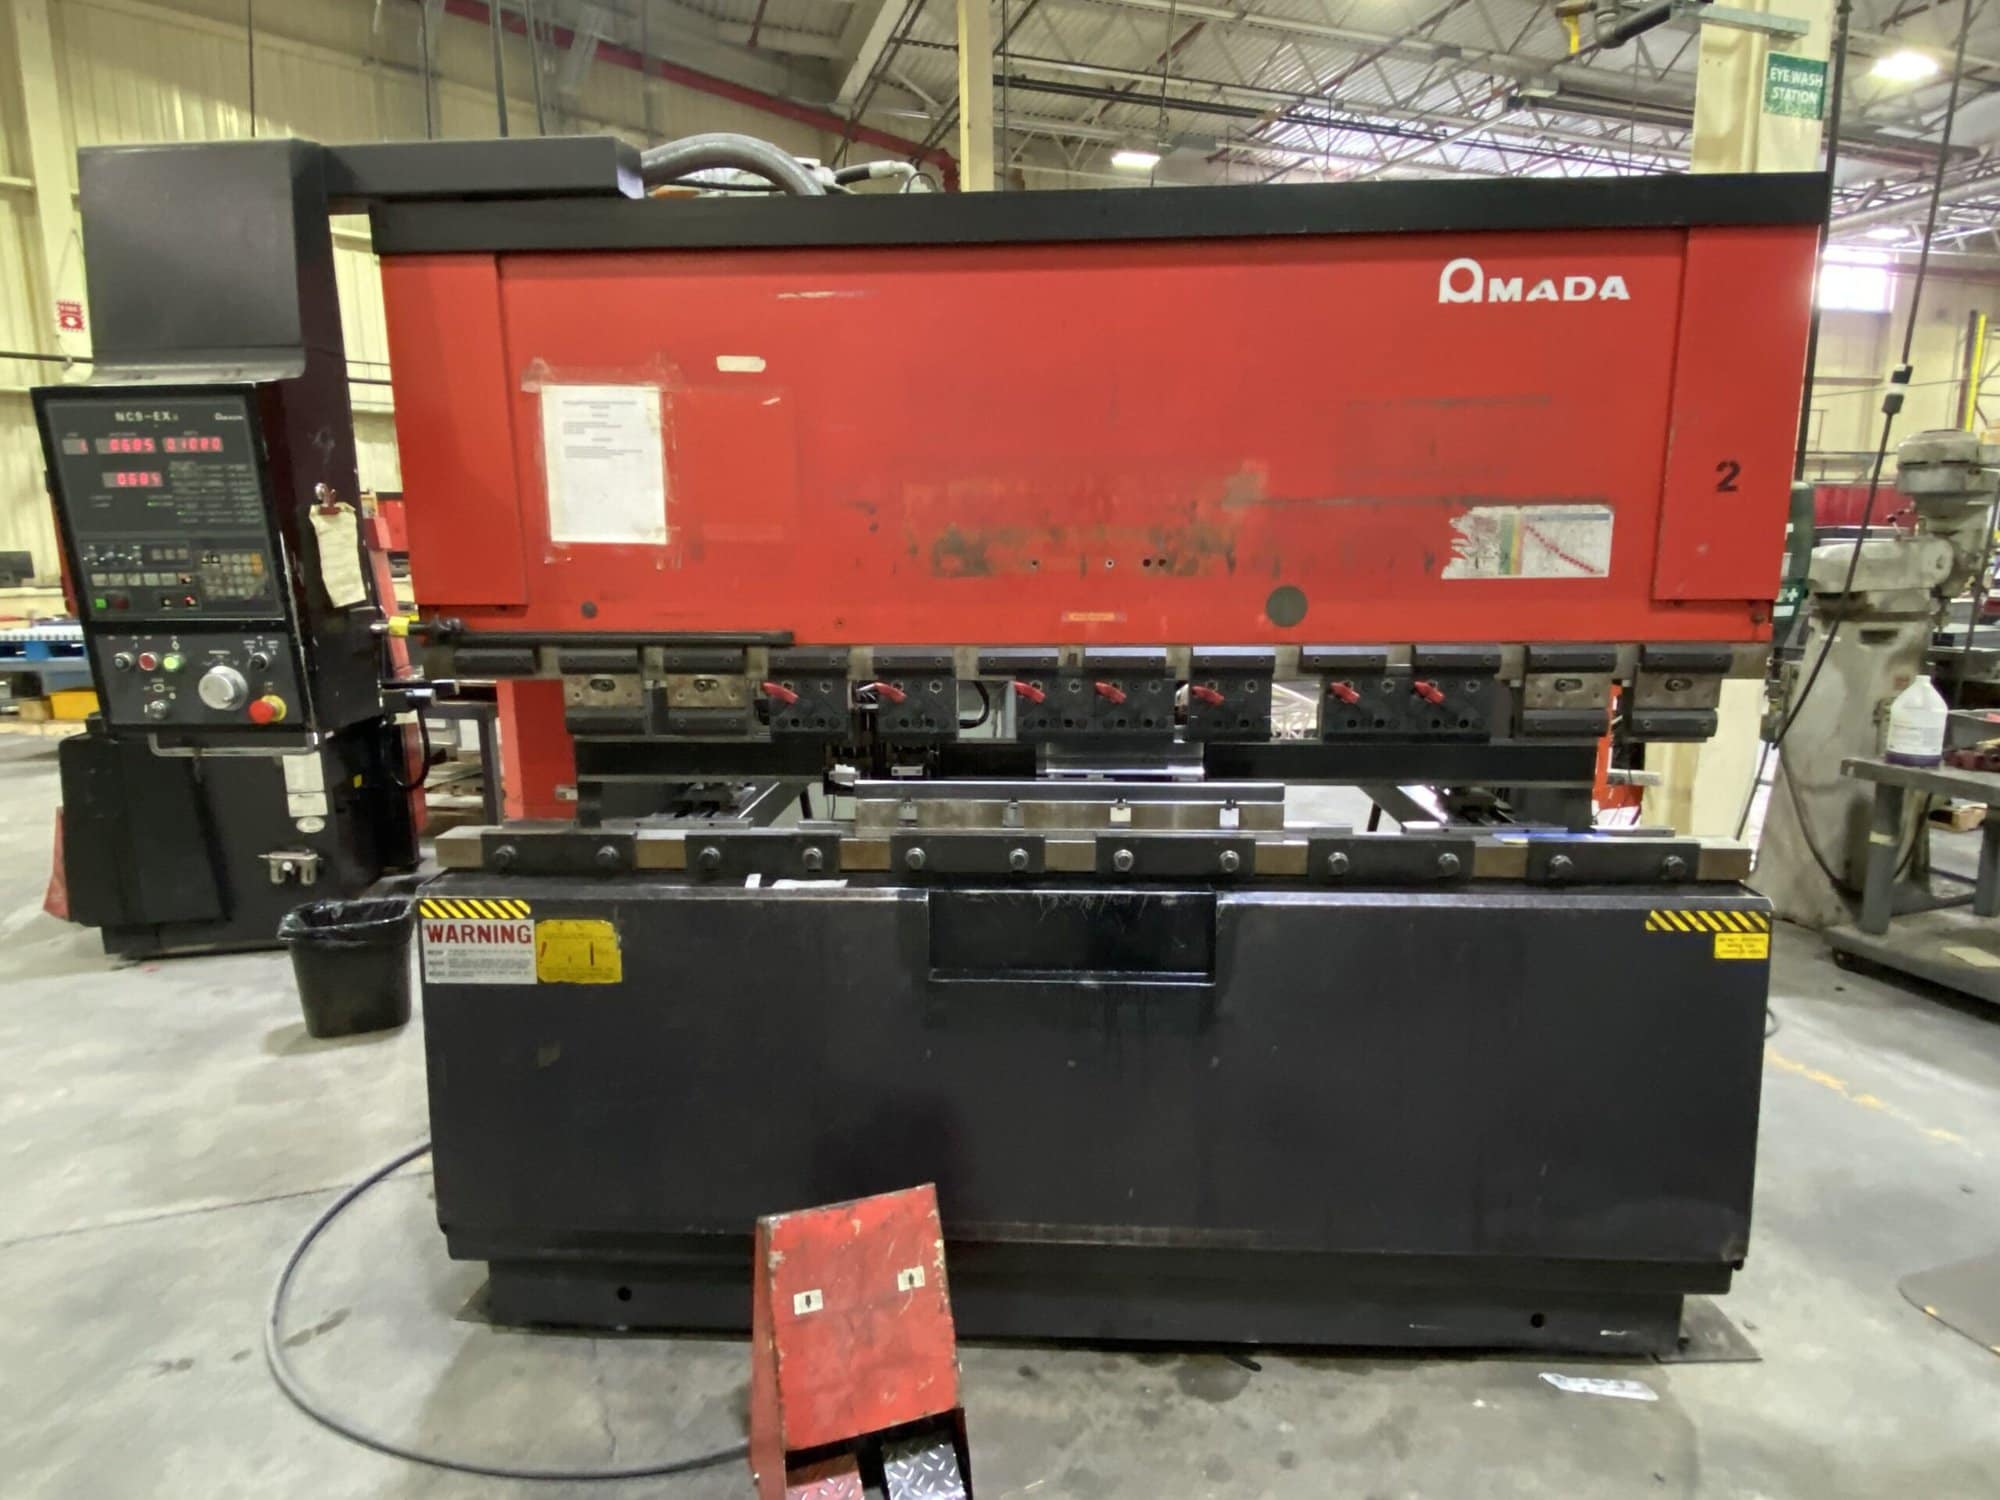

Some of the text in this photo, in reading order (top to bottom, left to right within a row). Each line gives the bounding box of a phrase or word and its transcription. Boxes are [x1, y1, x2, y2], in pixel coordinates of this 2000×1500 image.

[1769, 67, 1824, 88] EYE WASH
[1771, 86, 1819, 105] STATION
[1438, 258, 1631, 303] AMADA
[1715, 460, 1741, 493] 2
[426, 923, 532, 944] WARNING
